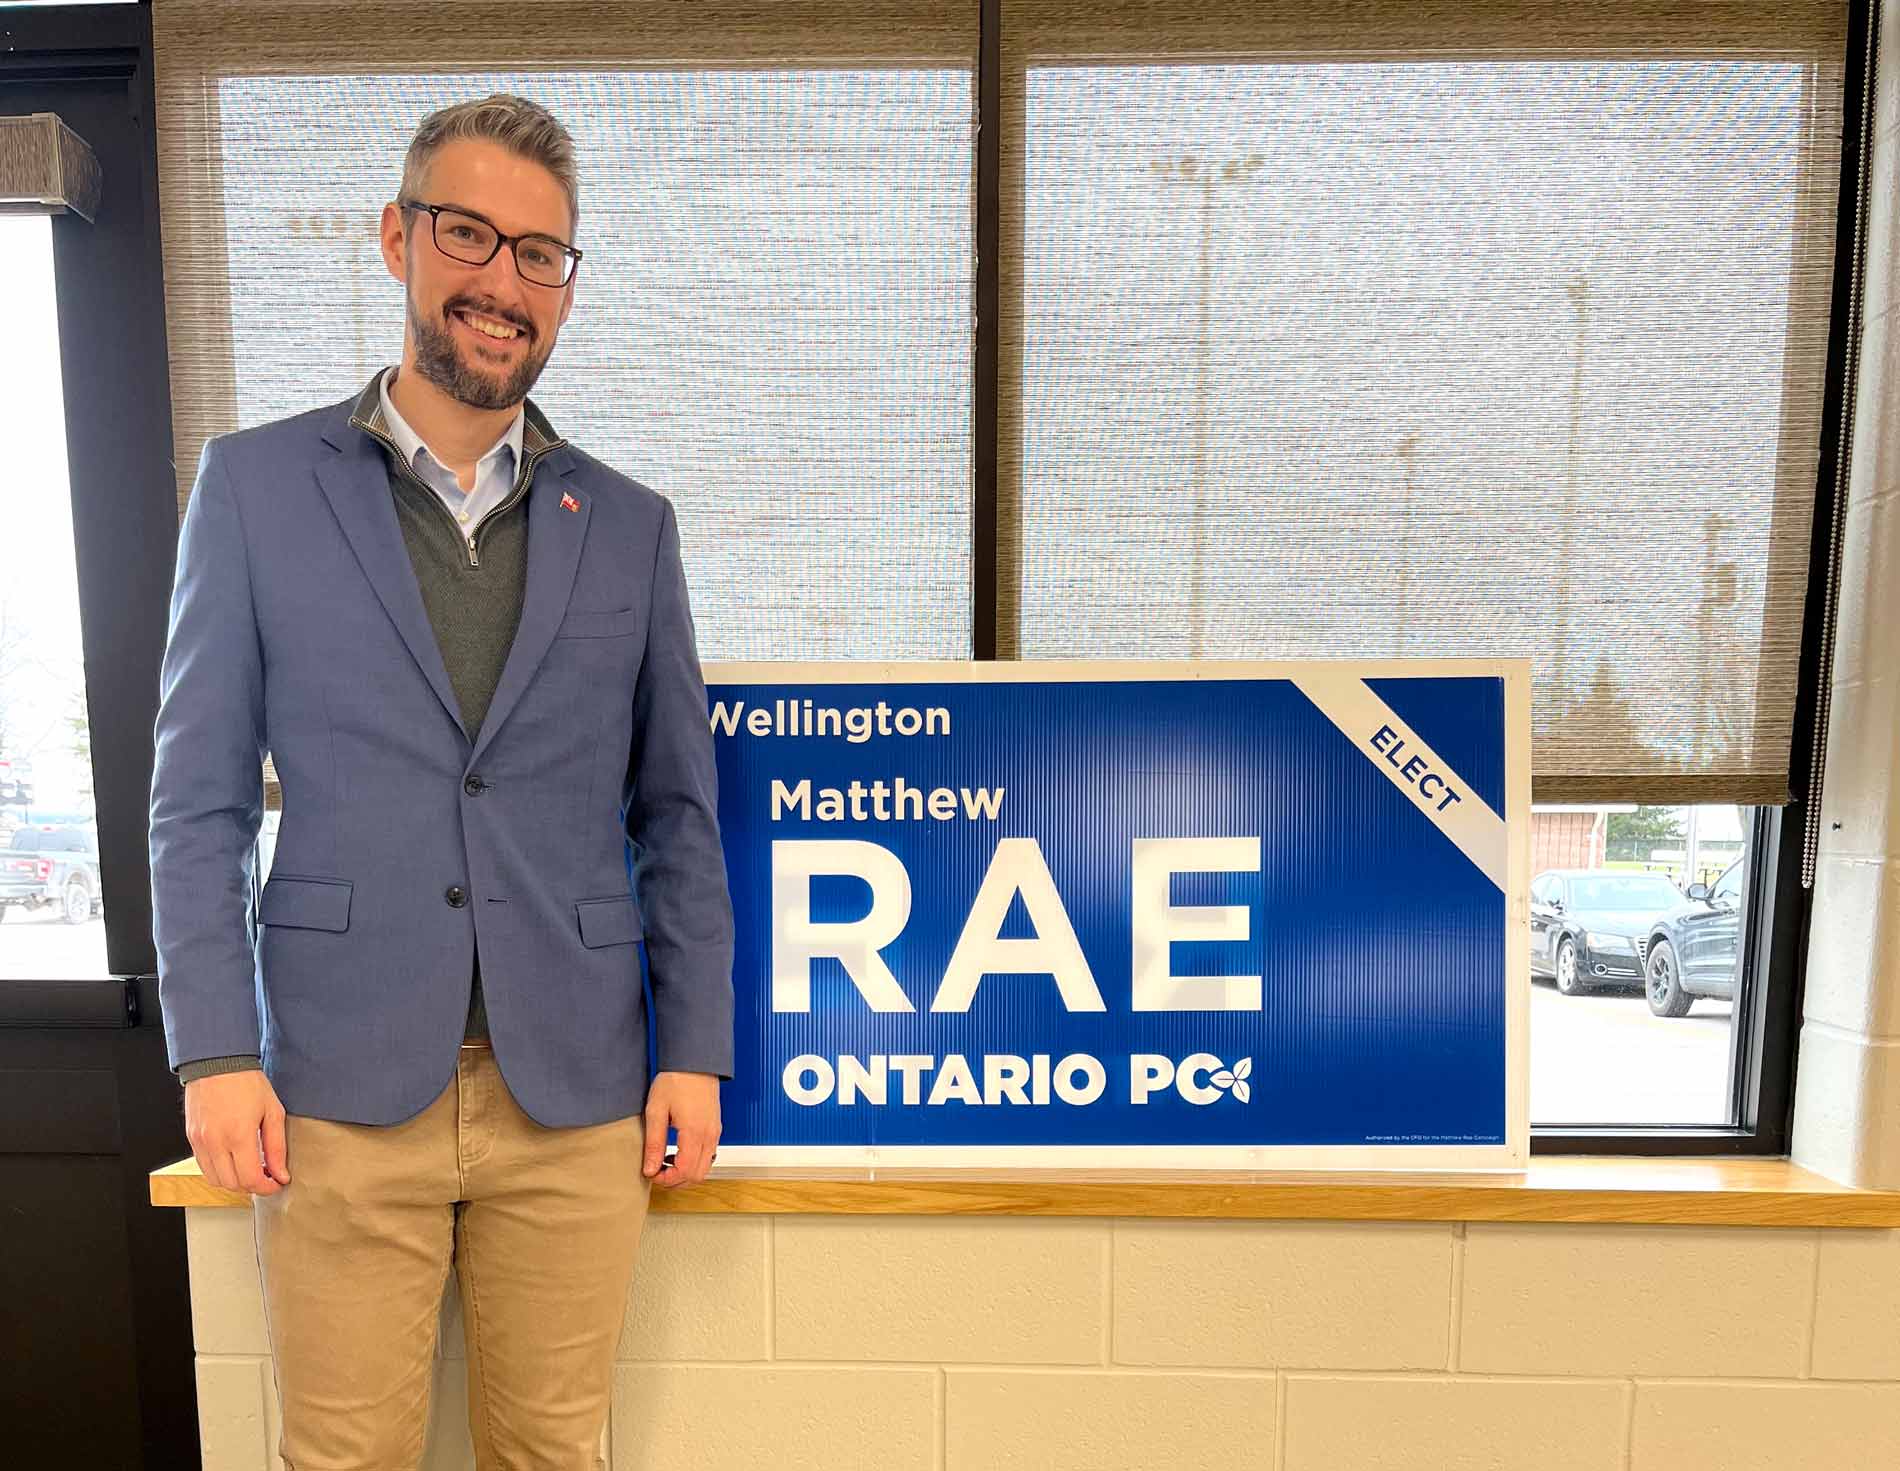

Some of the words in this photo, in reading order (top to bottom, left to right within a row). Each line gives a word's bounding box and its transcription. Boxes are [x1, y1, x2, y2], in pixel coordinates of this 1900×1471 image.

[710, 699, 951, 744] Wellington
[1369, 724, 1461, 811] ELECT
[771, 777, 1005, 821] Matthew
[772, 838, 1262, 1013] RAE
[782, 1053, 1107, 1106] ONTARIO
[1130, 1052, 1225, 1106] PC
